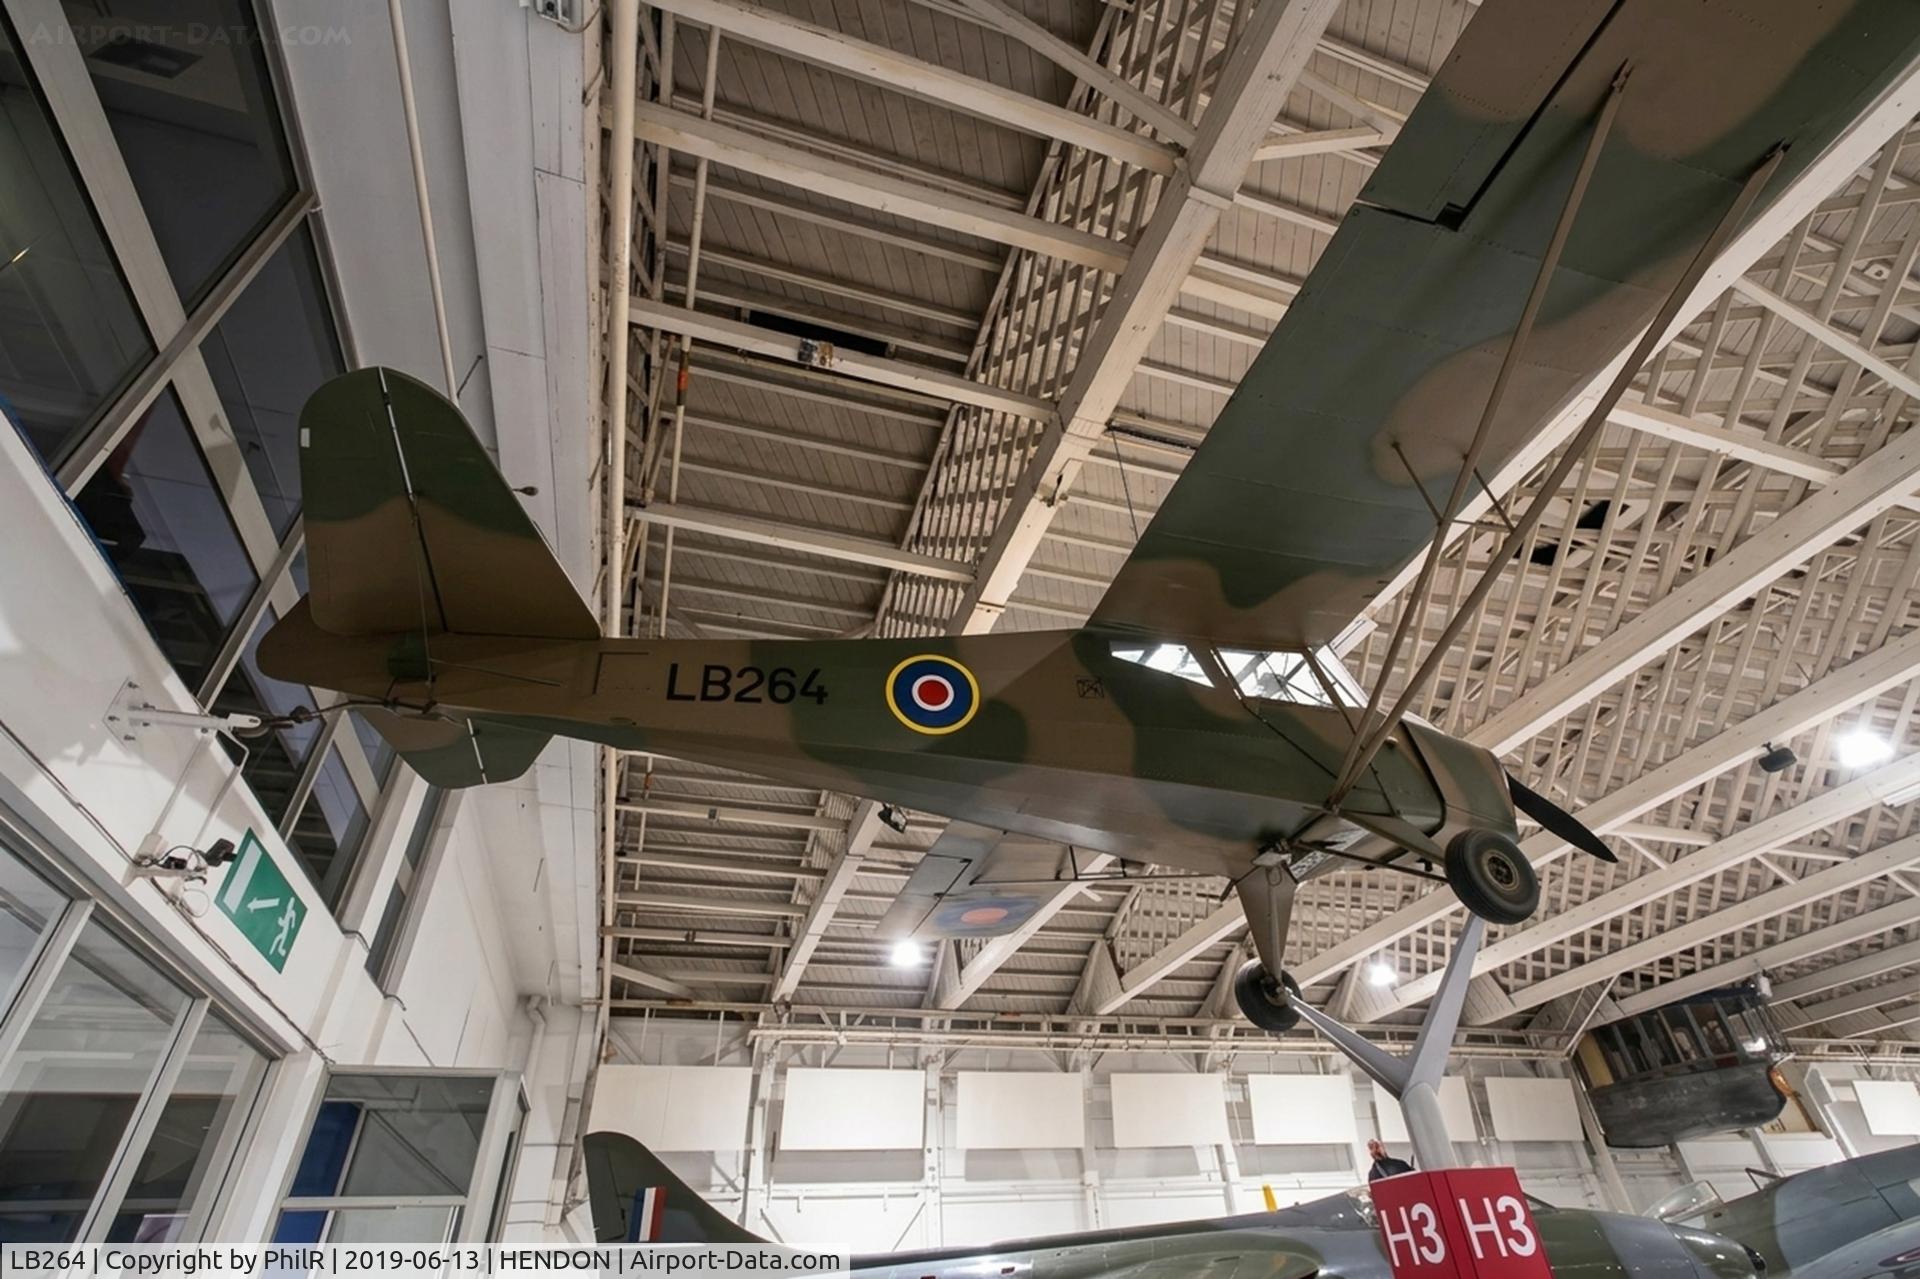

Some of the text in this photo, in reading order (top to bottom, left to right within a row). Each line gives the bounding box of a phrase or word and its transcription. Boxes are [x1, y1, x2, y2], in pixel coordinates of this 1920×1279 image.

[666, 663, 829, 705] LB264
[1380, 1202, 1446, 1268] H3
[1458, 1195, 1537, 1260] H3
